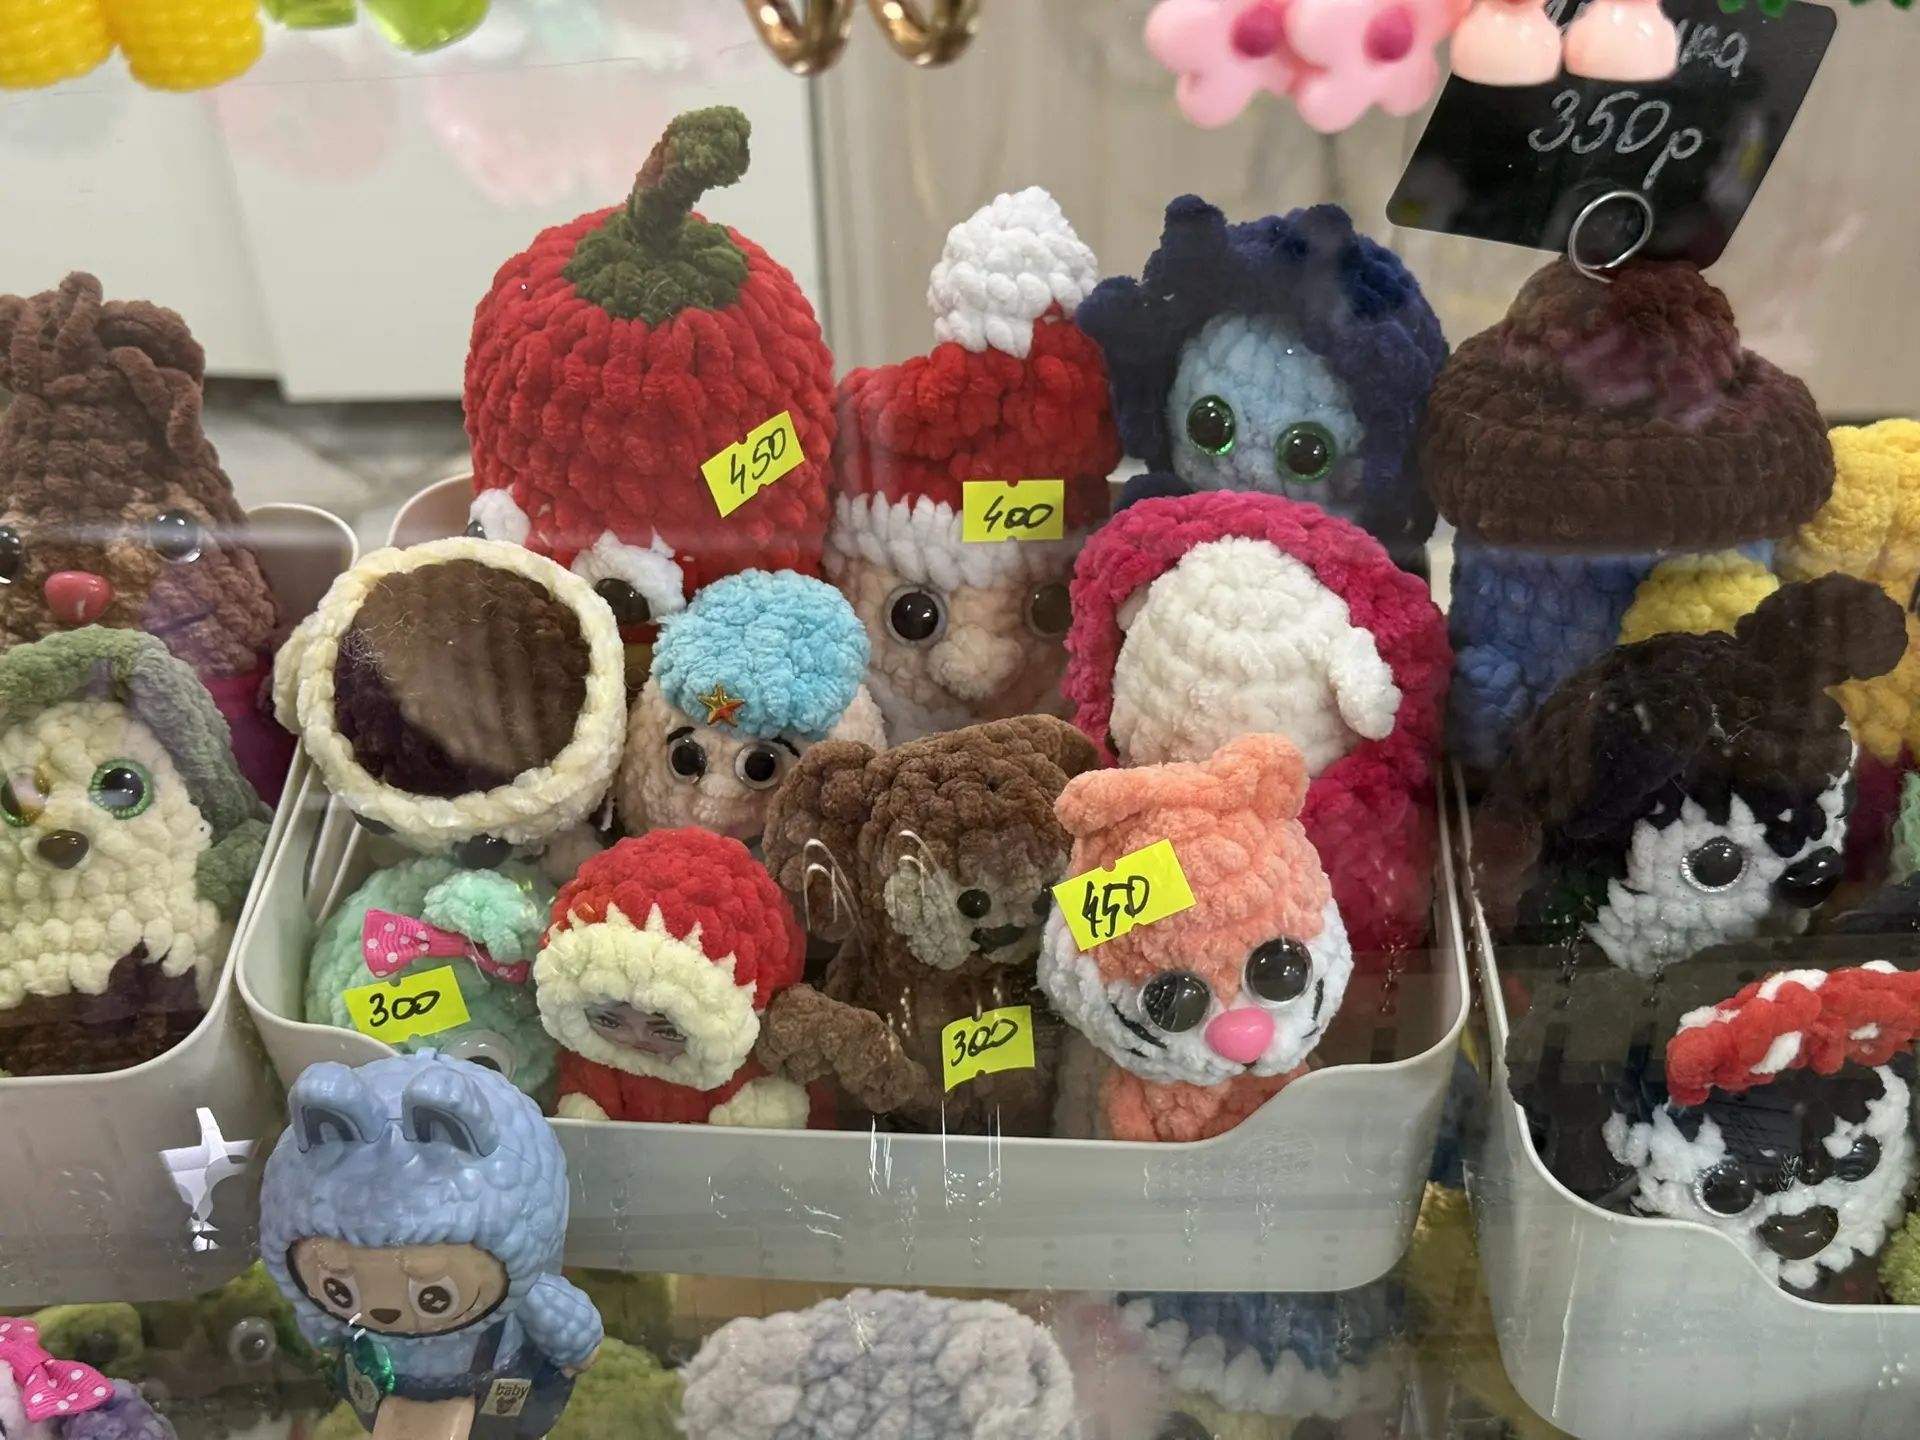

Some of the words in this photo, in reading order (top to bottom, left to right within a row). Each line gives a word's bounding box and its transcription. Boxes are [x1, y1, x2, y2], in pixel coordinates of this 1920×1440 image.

[729, 427, 787, 495] 450
[983, 495, 1054, 533] 400
[1081, 875, 1150, 938] 450
[369, 990, 441, 1027] 300
[950, 1018, 1019, 1067] 300
[495, 1383, 529, 1400] baby
